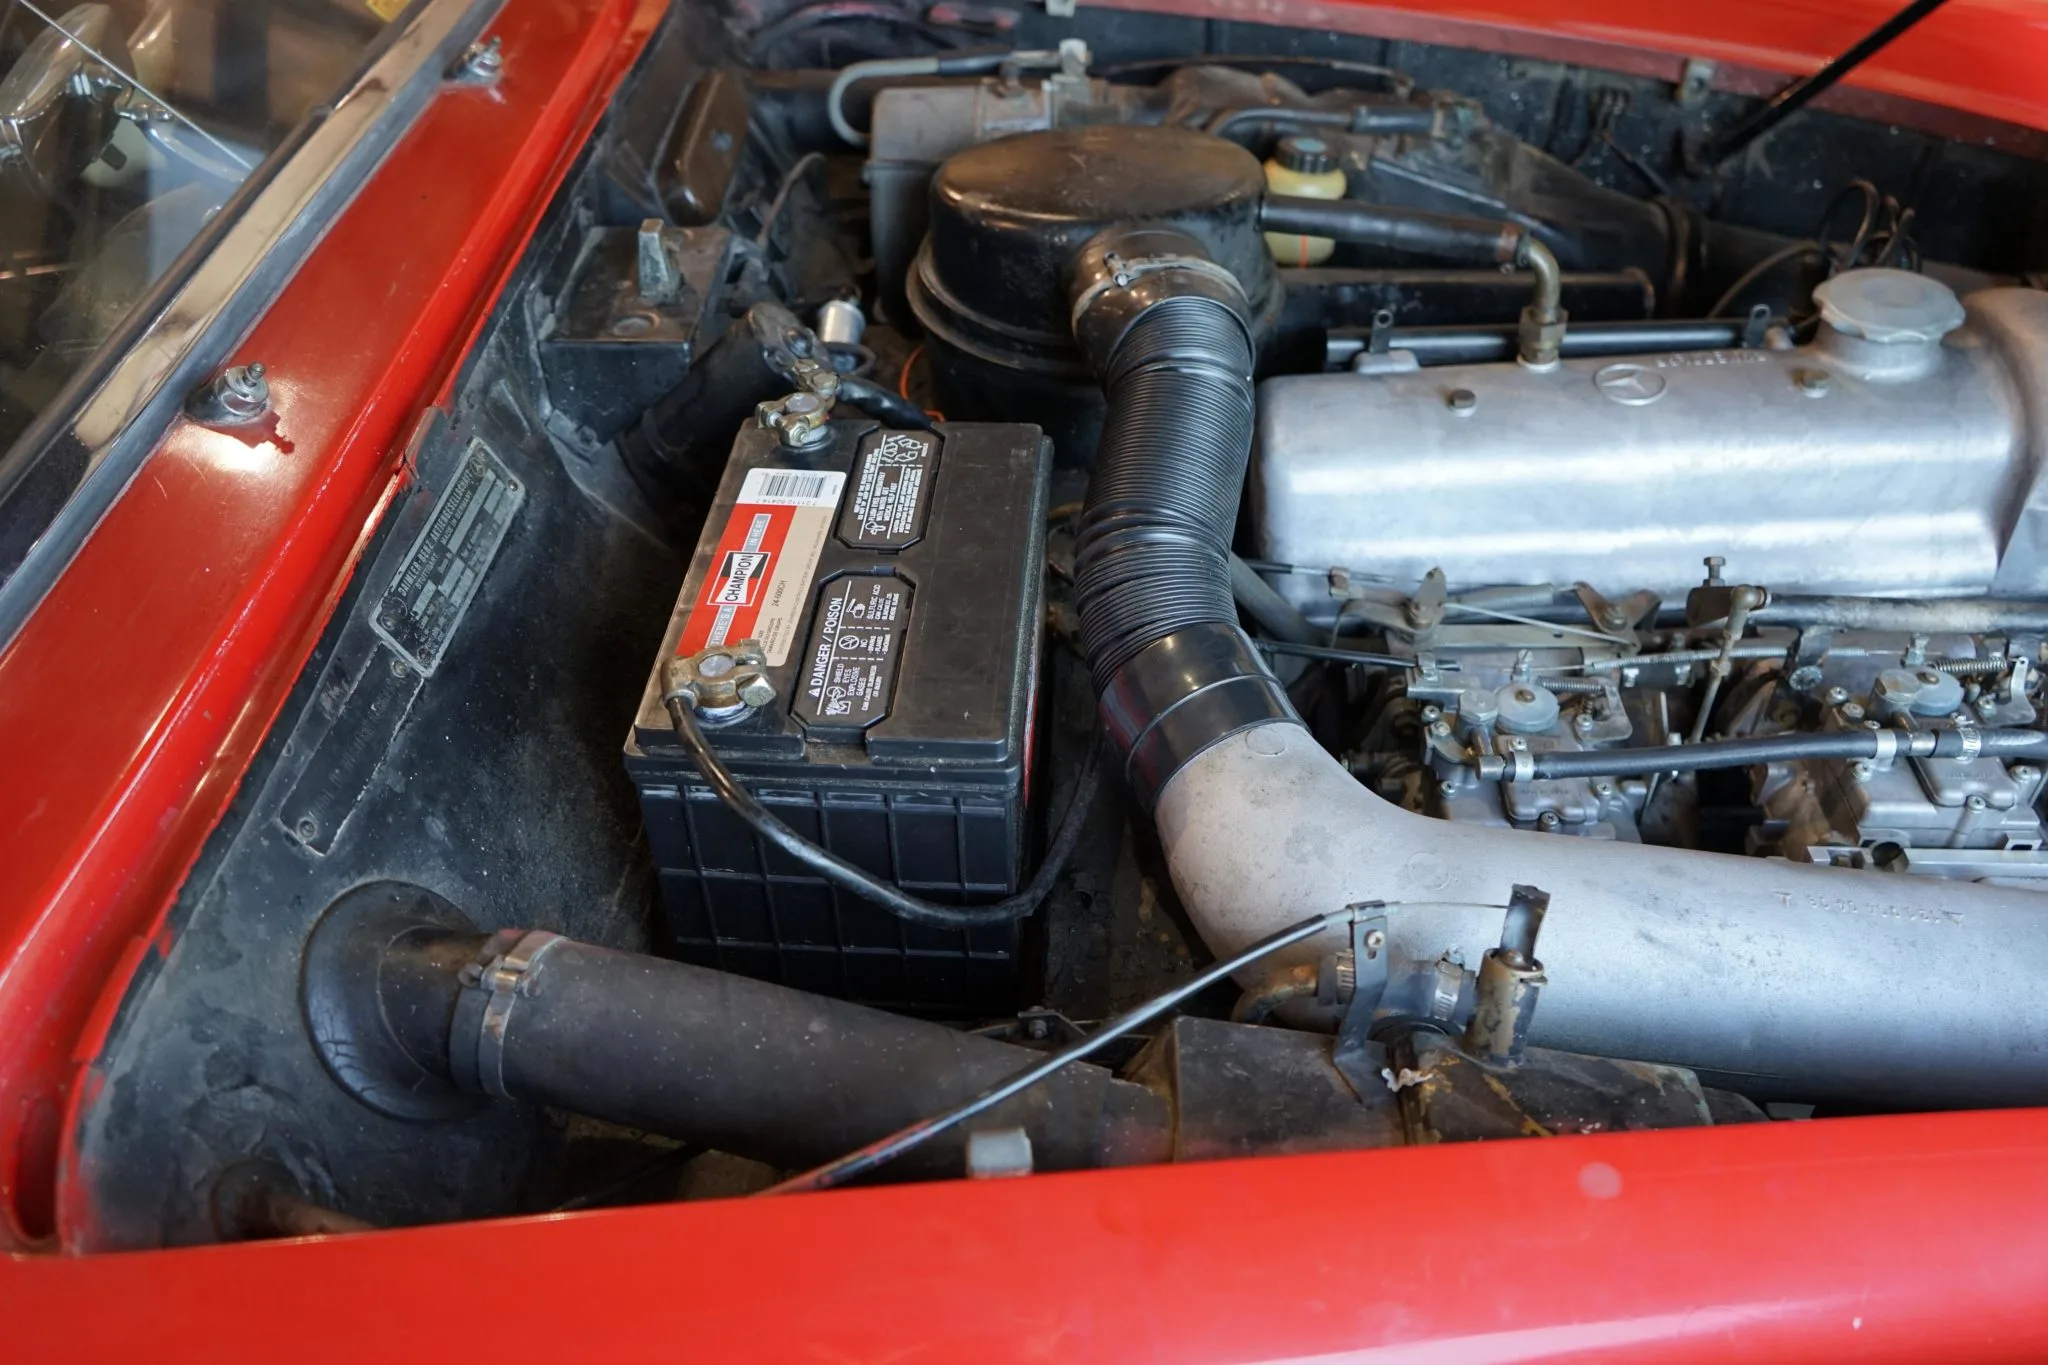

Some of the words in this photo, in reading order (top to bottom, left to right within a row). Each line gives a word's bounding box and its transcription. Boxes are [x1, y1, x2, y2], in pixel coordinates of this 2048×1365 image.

[430, 470, 473, 540] AKTIENGESELLSCHAFT
[751, 519, 766, 537] HERE
[749, 537, 760, 546] IN
[415, 553, 438, 590] STUTTGART
[725, 554, 753, 602] CHAMPION
[872, 584, 881, 596] ACID
[867, 596, 878, 620] SULFURIC
[810, 643, 831, 687] DANGER
[823, 597, 843, 634] POISON
[860, 638, 868, 648] NO
[833, 663, 845, 684] SHIELD
[842, 668, 852, 683] EYES
[847, 667, 860, 696] EXPLOSIVE
[856, 677, 867, 696] GASES
